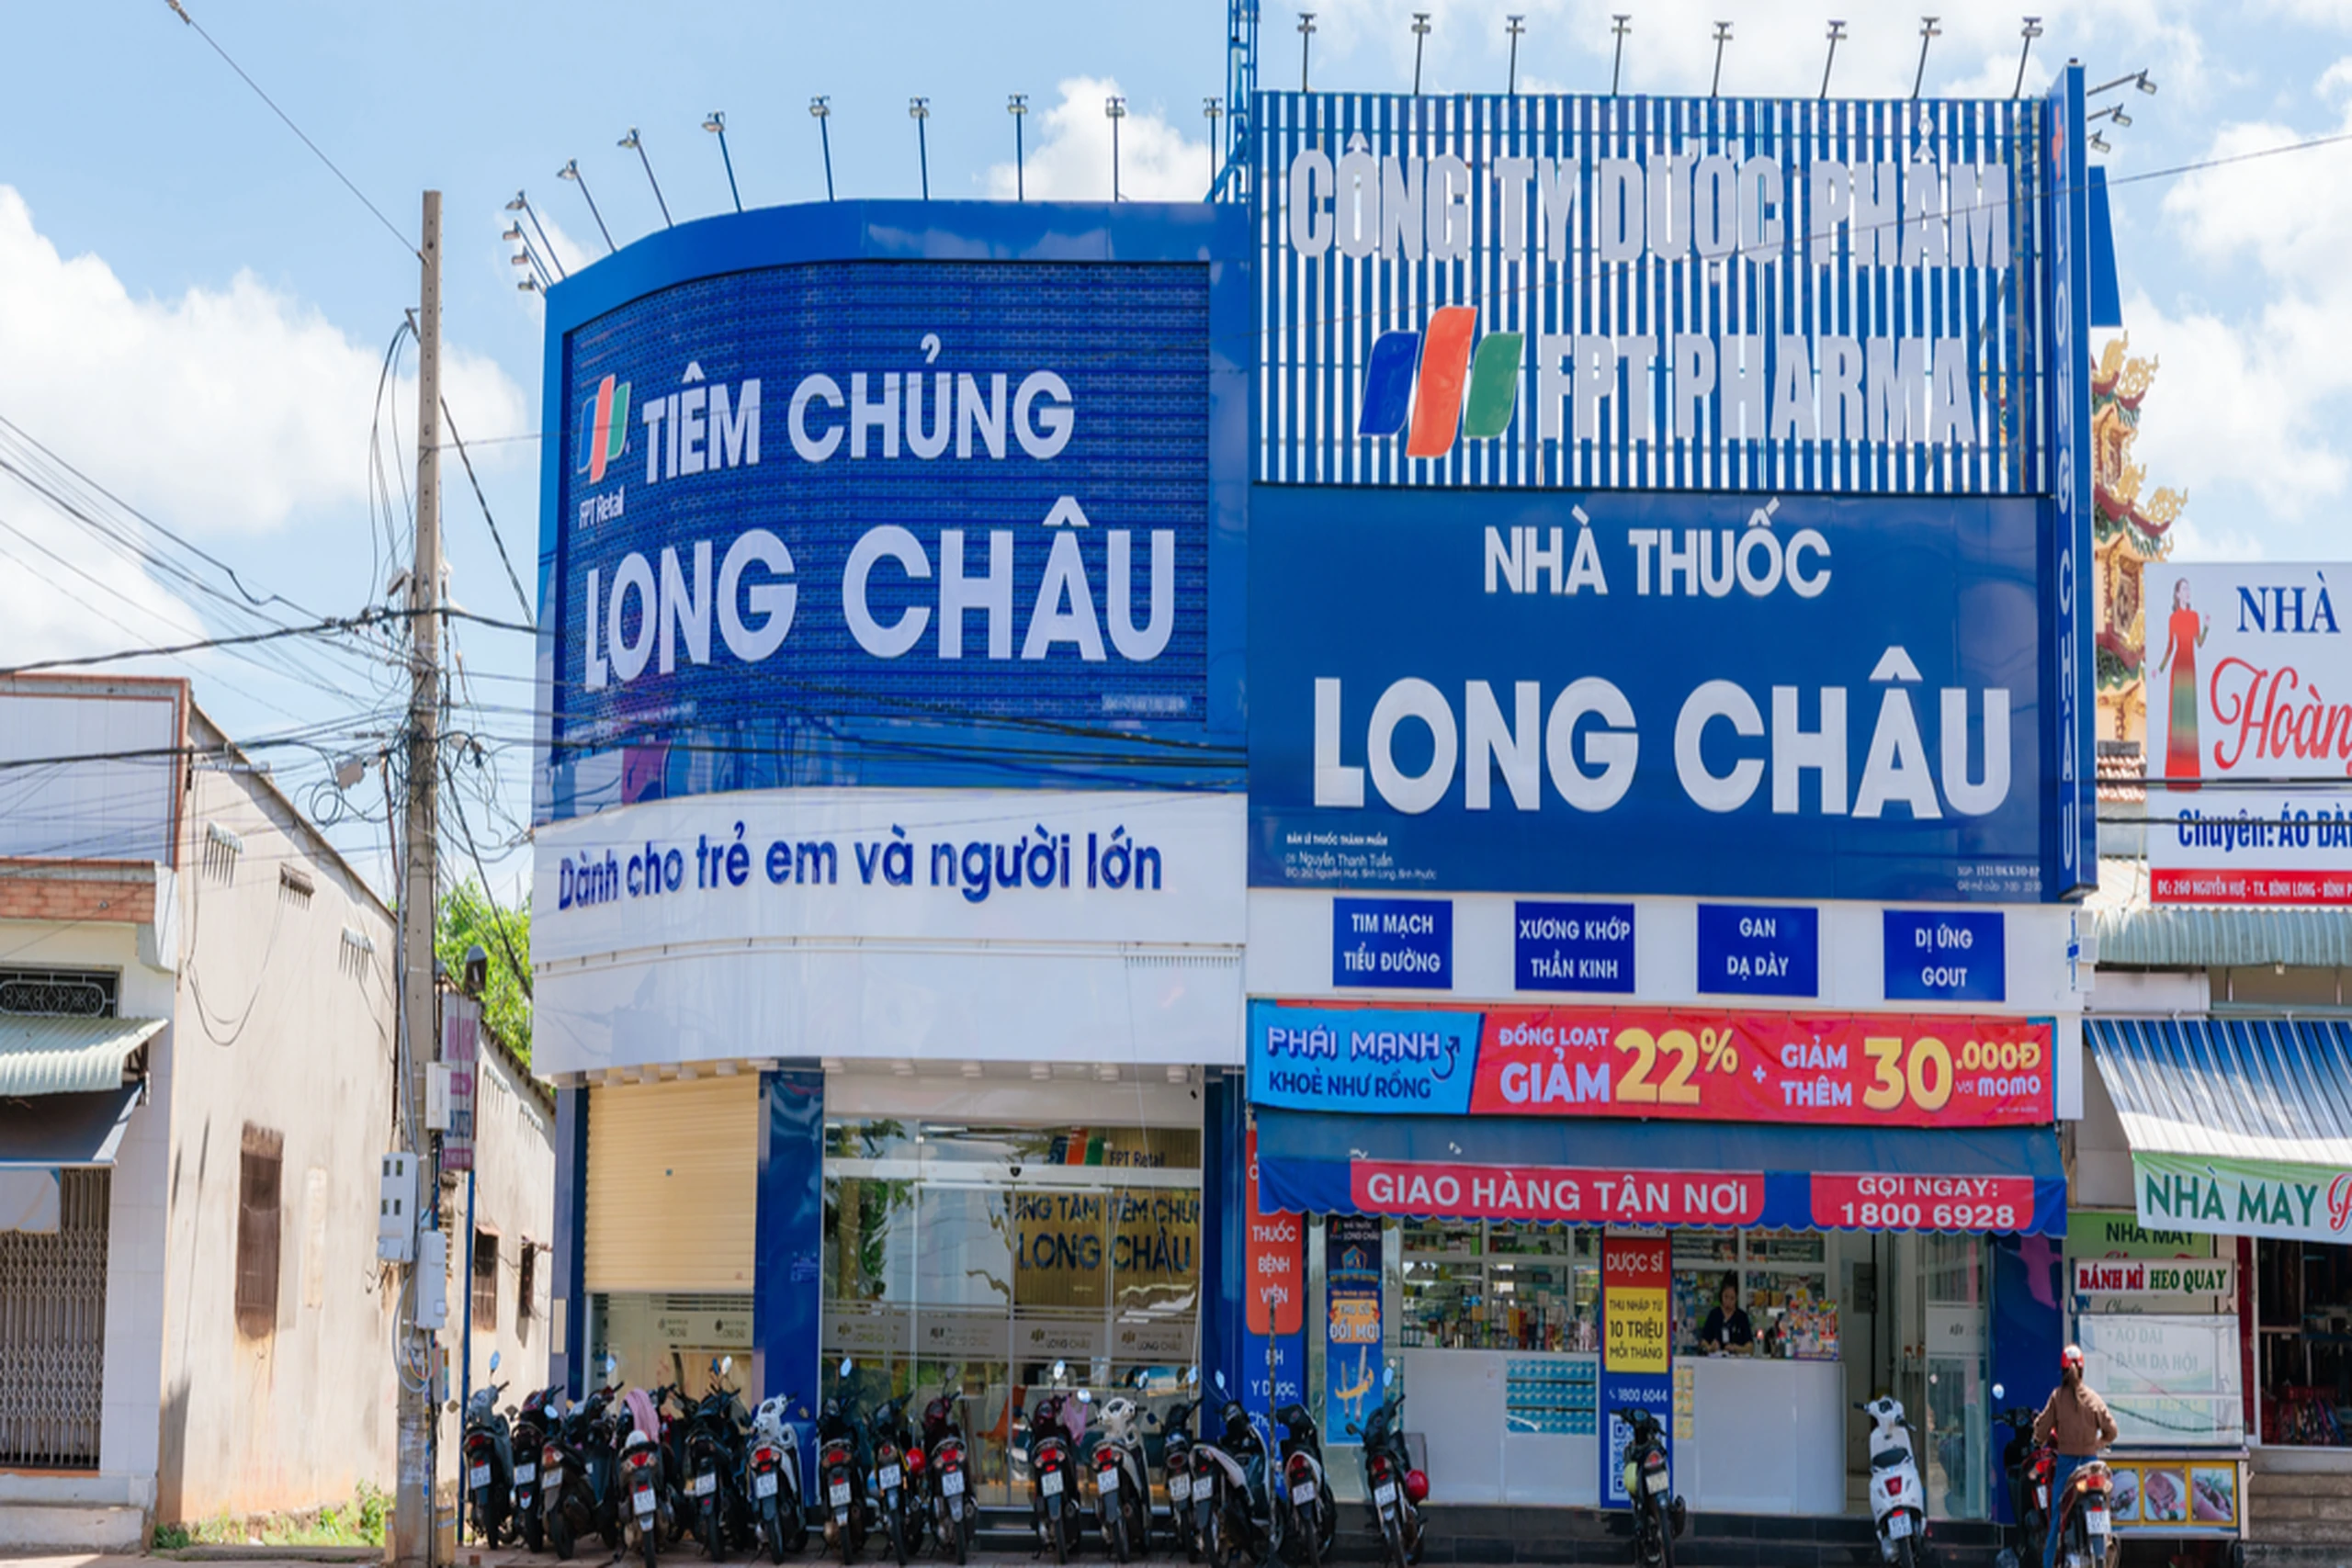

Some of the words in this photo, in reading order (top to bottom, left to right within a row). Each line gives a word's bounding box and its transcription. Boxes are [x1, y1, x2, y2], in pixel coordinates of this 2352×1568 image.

[1289, 131, 1470, 261] CÔNG
[1494, 156, 1579, 263] TY
[1600, 138, 1784, 282] DƯỢC
[1810, 118, 2009, 269] PHẨM
[1540, 333, 1657, 443] FPT
[1674, 333, 1976, 444] PHARMA
[643, 360, 761, 484] TIÊM
[788, 333, 1075, 462] CHỦNG
[1485, 503, 1609, 595] NHÀ
[1629, 497, 1832, 599] THUỐC
[584, 528, 798, 694] LONG
[842, 495, 1175, 662] CHÂU
[2236, 570, 2341, 634] NHÀ
[1314, 676, 1639, 815] LONG
[1673, 645, 2011, 819] CHÂU
[2210, 656, 2352, 778] Hoàn
[2178, 808, 2274, 852] Chuyên:
[558, 851, 618, 910] Dành
[626, 840, 684, 897] cho
[697, 821, 750, 890] trẻ
[765, 840, 837, 886] em
[854, 823, 912, 887] và
[931, 823, 1070, 903] người
[1088, 824, 1163, 891] lớn
[1351, 913, 1378, 933] TIM
[1384, 914, 1434, 939] MẠCH
[1520, 919, 1580, 941] XƯƠNG
[1585, 916, 1631, 942] KHỚP
[1739, 917, 1777, 938] GAN
[1916, 928, 1933, 953] DỊ
[1937, 922, 1973, 950] ỨNG
[1343, 942, 1375, 972] TIỂU
[1380, 949, 1441, 973] ĐƯỜNG
[1531, 949, 1574, 978] THẦN
[1579, 958, 1618, 979] KINH
[1727, 955, 1751, 981] DẠ
[1755, 950, 1790, 977] DÀY
[1922, 966, 1968, 988] GOUT
[1268, 1023, 1338, 1062] PHÁI
[1351, 1029, 1442, 1066] MẠNH
[1560, 1027, 1610, 1054] LOẠT
[1781, 1035, 1849, 1070] GIẢM
[1499, 1047, 1611, 1104] GIẢM
[1613, 1026, 1739, 1106] 22%
[1328, 1073, 1372, 1098] NHƯ
[1781, 1077, 1853, 1108] THÊM
[1110, 1150, 1129, 1168] FPT
[1367, 1173, 1461, 1207] GIAO
[1472, 1170, 1580, 1212] HÀNG
[1593, 1175, 1670, 1219] TẬN
[1857, 1177, 1905, 1199] GỌI
[1915, 1178, 1998, 1198] NGAY:
[2146, 1166, 2225, 1221] NHÀ
[2238, 1180, 2319, 1226] MAY
[1840, 1201, 1921, 1226] 1800
[1933, 1204, 2015, 1227] 6928
[1252, 1219, 1296, 1243] THUỐC
[1018, 1232, 1102, 1270] LONG
[1111, 1225, 1191, 1273] CHÂU
[1258, 1251, 1290, 1278] BỆNH
[1606, 1250, 1647, 1278] DƯỢC
[2079, 1262, 2123, 1291] BÁNH
[2125, 1262, 2143, 1291] MÌ
[2149, 1269, 2180, 1291] HEO
[2183, 1269, 2227, 1294] QUAY
[1610, 1320, 1623, 1338] 10
[1626, 1316, 1664, 1345] TRIỆU
[1617, 1387, 1640, 1404] 1800
[1642, 1388, 1668, 1404] 6044
